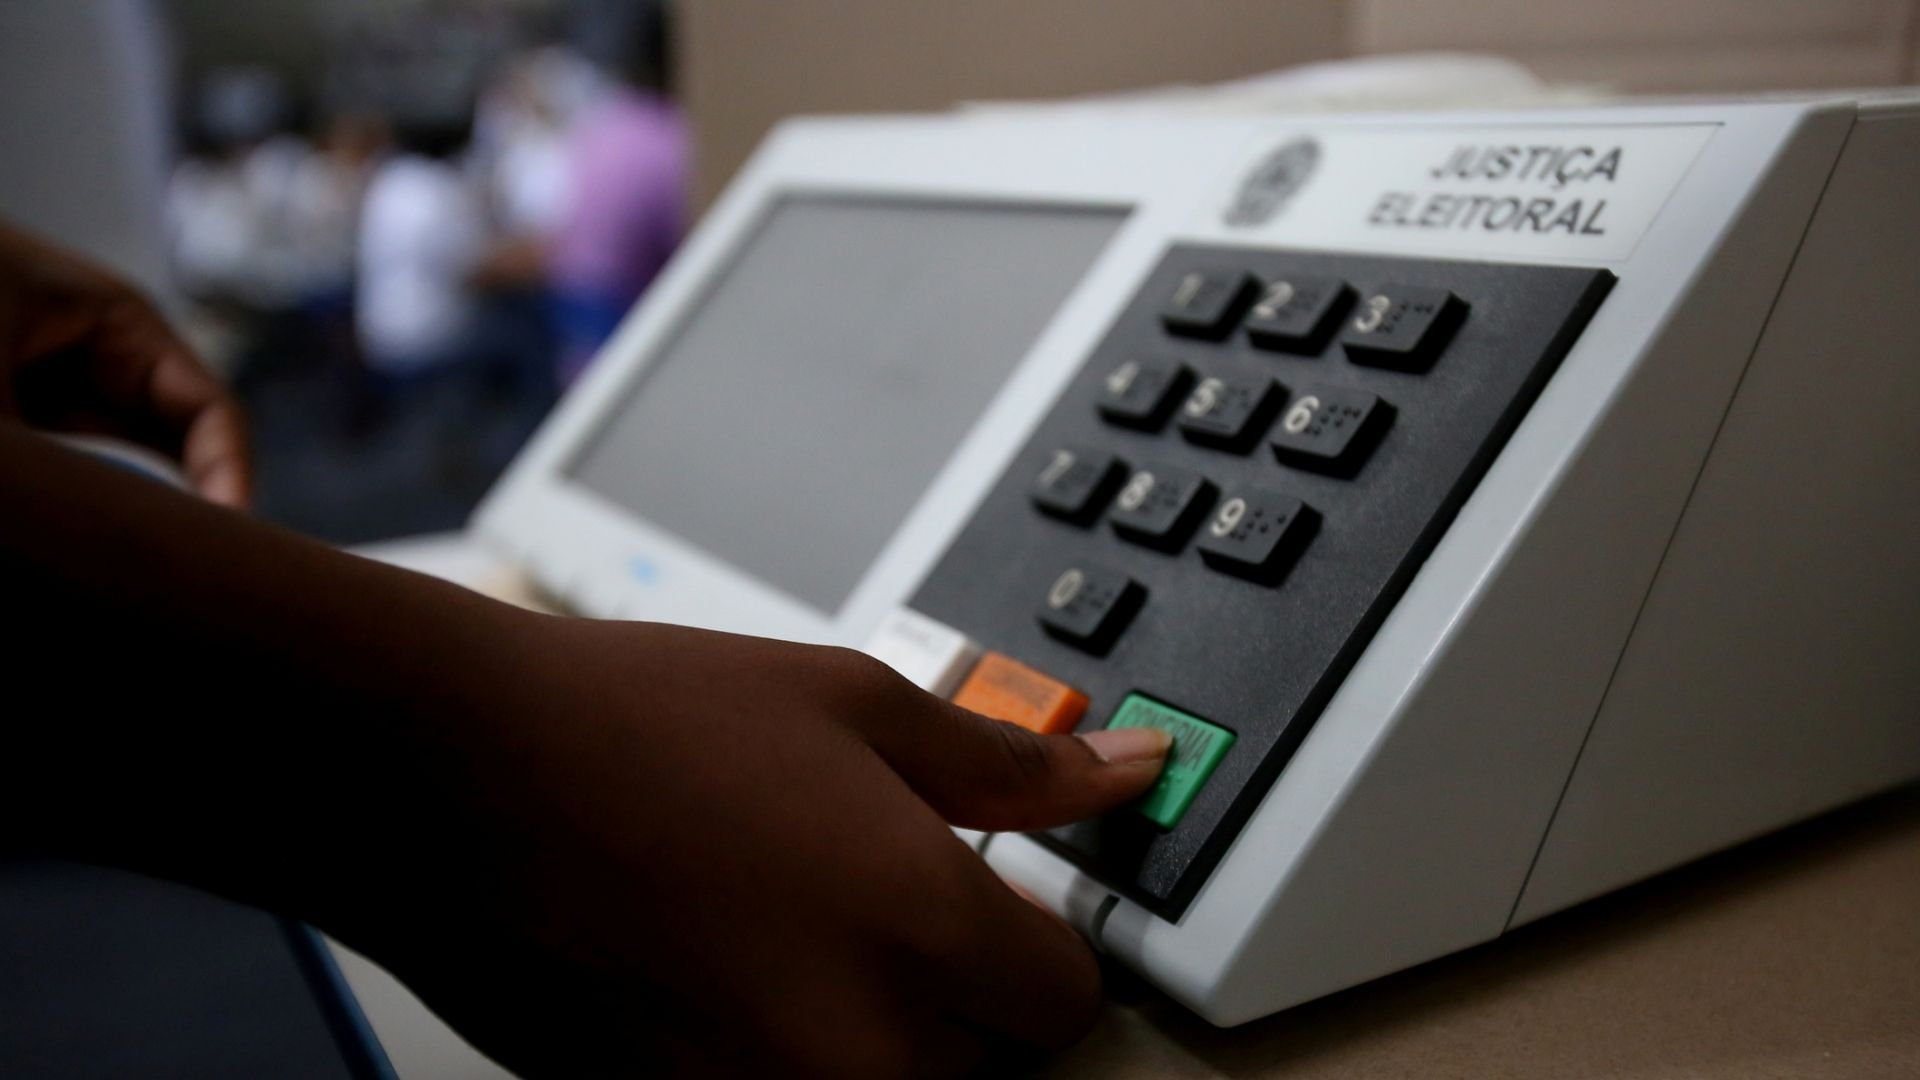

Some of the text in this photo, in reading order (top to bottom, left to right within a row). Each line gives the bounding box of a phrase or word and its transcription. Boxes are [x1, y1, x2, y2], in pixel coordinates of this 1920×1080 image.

[1429, 145, 1623, 192] JUSTIÇA
[1367, 193, 1609, 235] ELEITORAL
[1252, 281, 1294, 320] 2
[1353, 295, 1391, 333] 3
[1105, 360, 1140, 394] 4
[1183, 378, 1225, 418] 5
[1284, 396, 1320, 433] 6
[1117, 471, 1156, 511] 8
[1210, 498, 1246, 537] 9
[1047, 568, 1084, 609] 0
